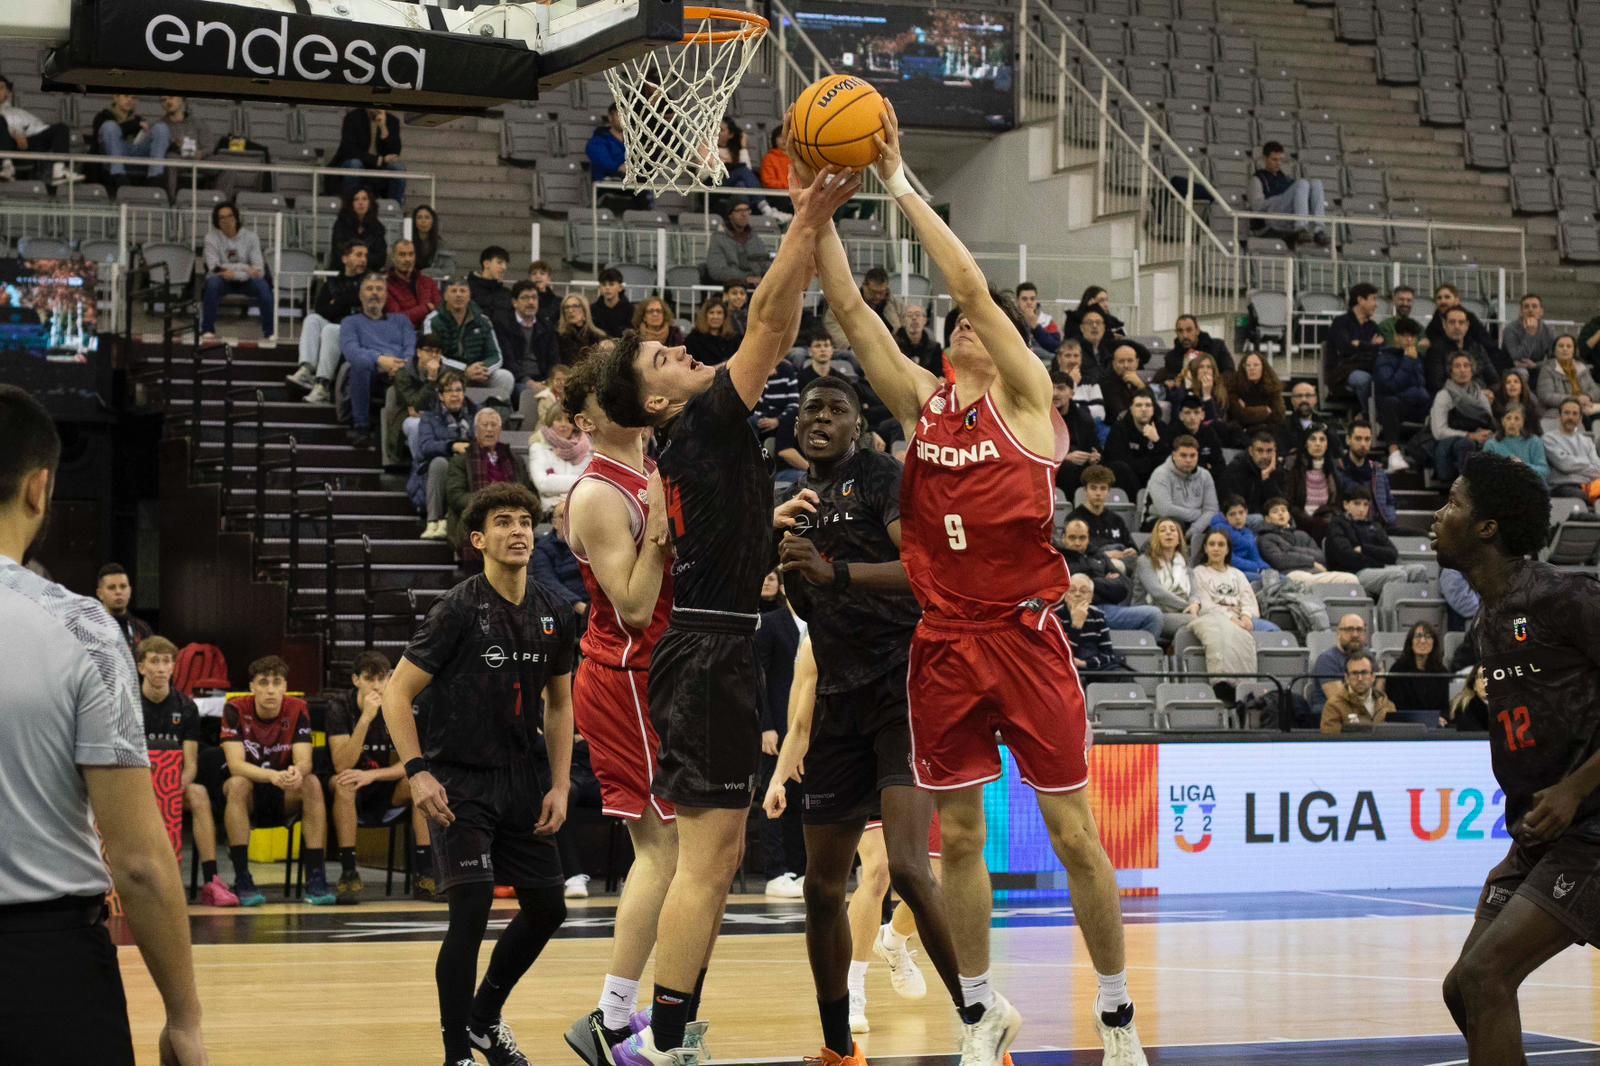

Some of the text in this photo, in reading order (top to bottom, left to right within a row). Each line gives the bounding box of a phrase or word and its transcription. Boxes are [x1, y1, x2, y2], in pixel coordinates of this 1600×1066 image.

[145, 13, 427, 91] endesa
[943, 513, 968, 551] 9
[1496, 705, 1537, 753] 12
[723, 782, 746, 791] vive
[1169, 784, 1216, 802] LIGA
[1245, 787, 1513, 844] LIGA U22
[459, 859, 479, 868] vive
